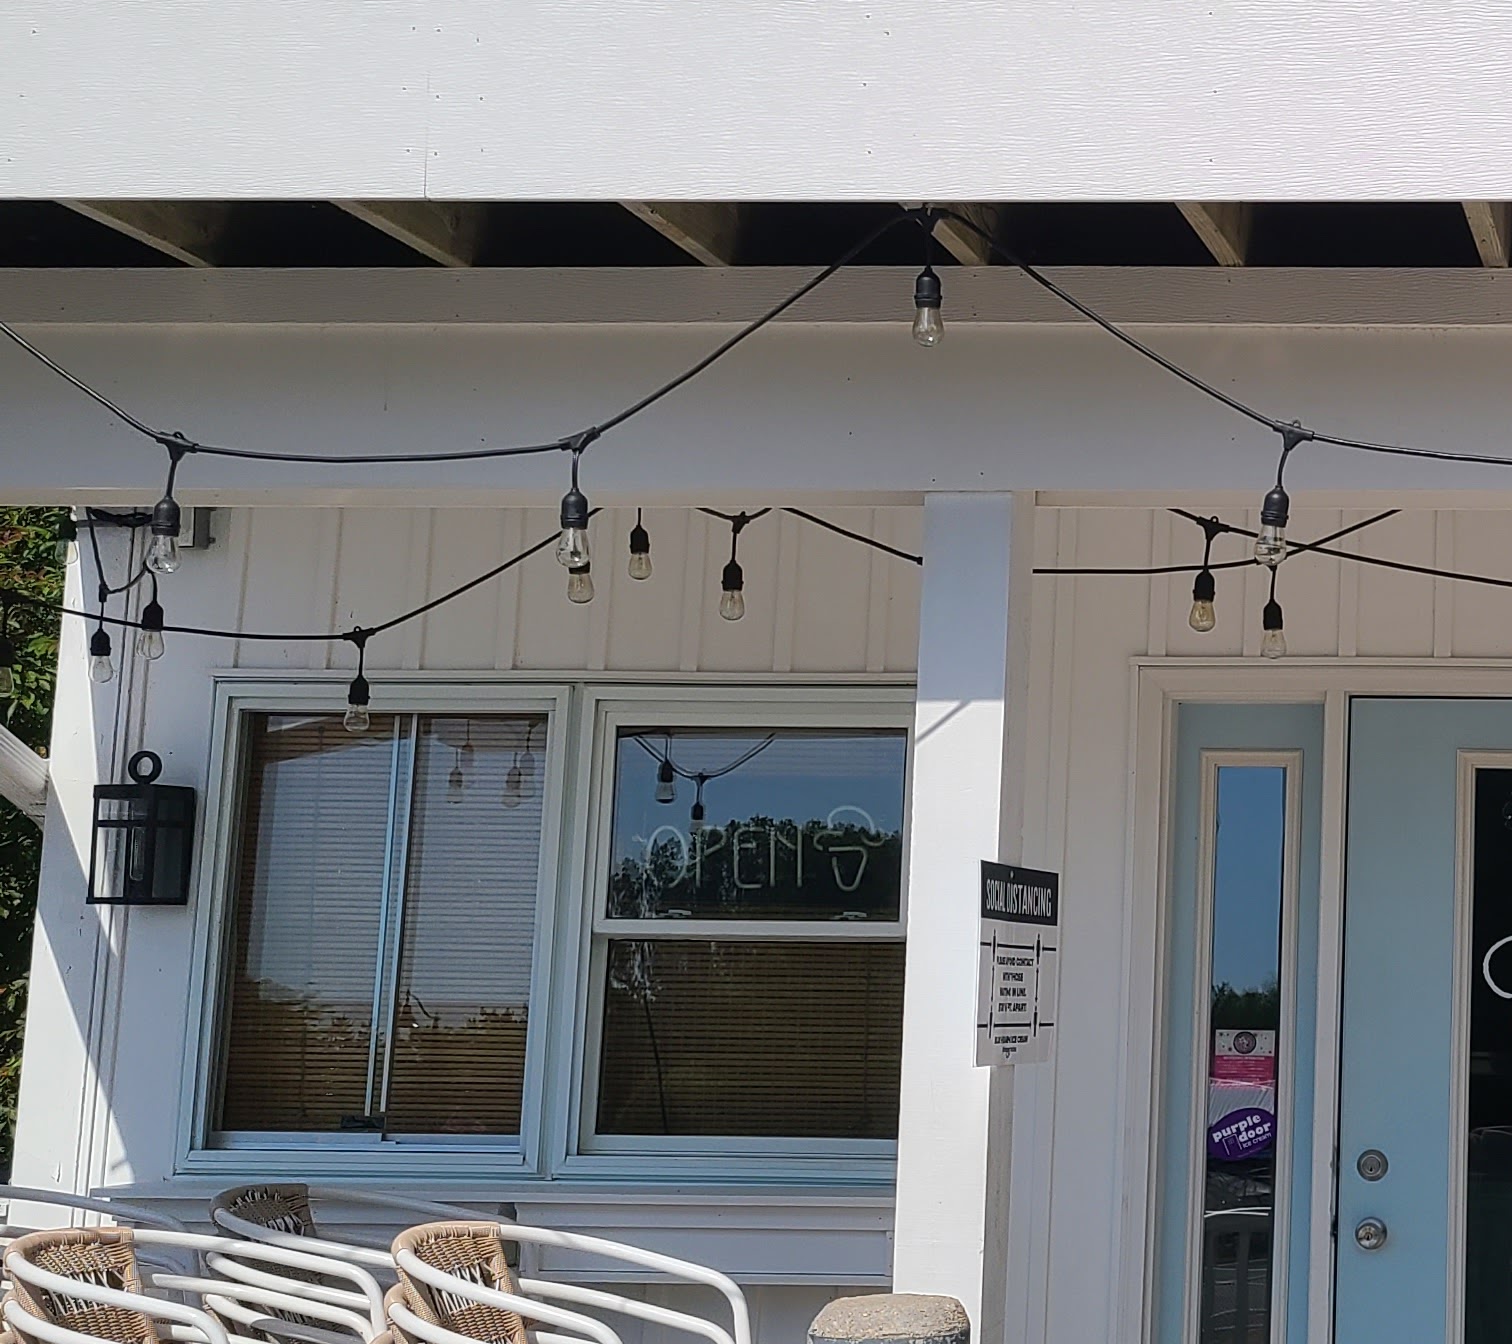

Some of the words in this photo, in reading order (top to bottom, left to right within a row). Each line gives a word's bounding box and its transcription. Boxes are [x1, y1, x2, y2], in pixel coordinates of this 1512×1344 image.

[646, 824, 803, 890] OPEN
[986, 877, 1006, 913] SOCIAL
[1006, 882, 1052, 917] DISTANCING
[1212, 1115, 1261, 1143] purple
[1238, 1123, 1271, 1142] door
